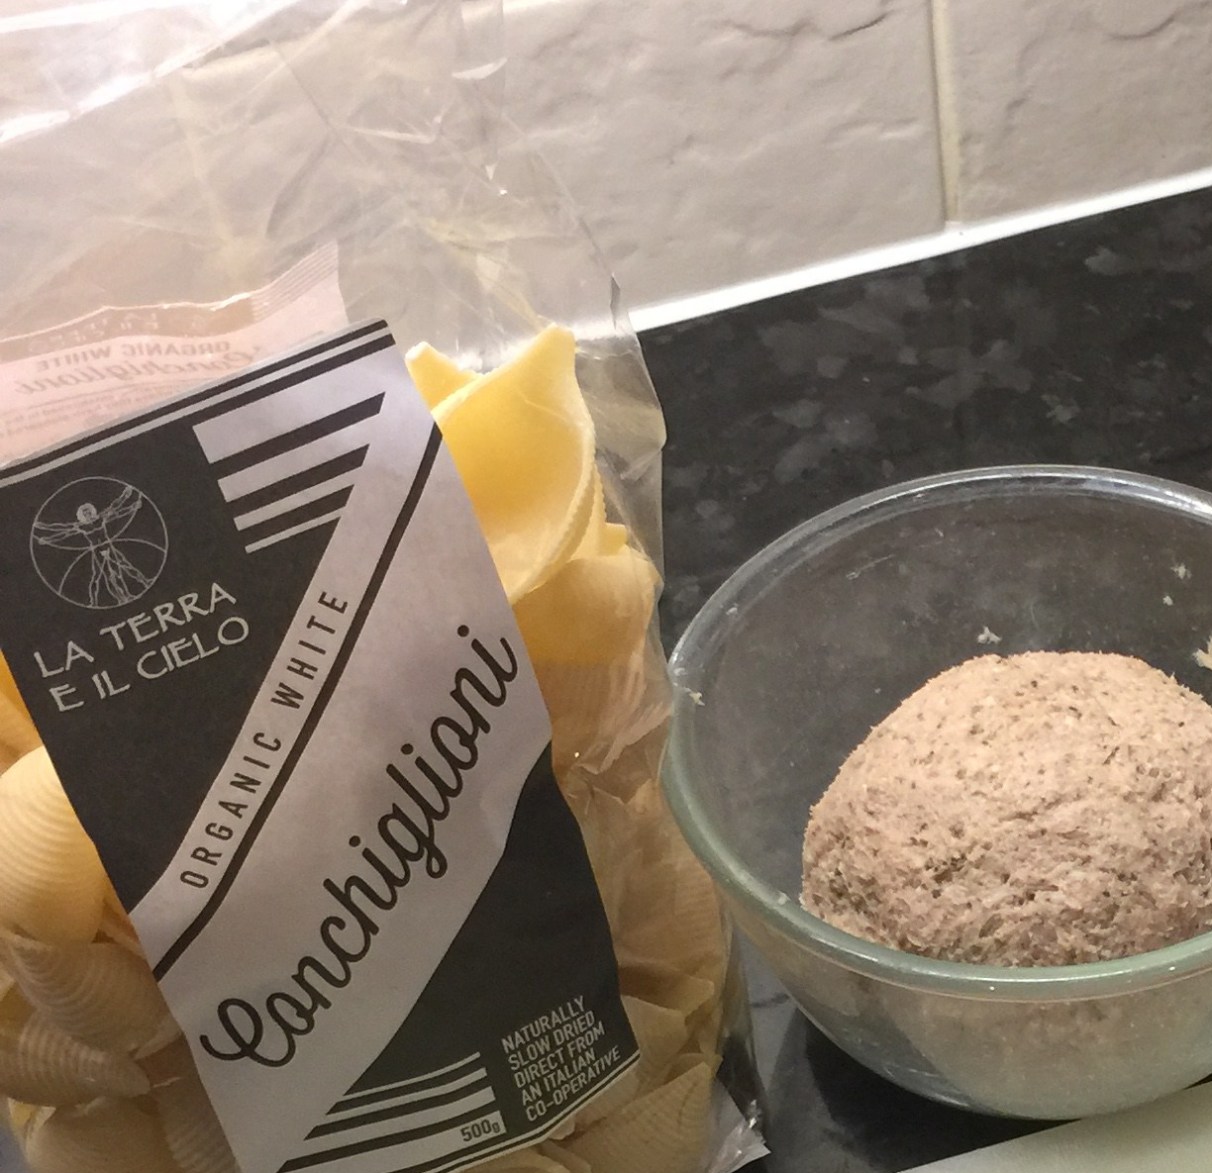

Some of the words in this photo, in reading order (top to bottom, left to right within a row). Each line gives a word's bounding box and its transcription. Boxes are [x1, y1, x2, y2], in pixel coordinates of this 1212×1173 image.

[34, 640, 94, 678] LA
[100, 582, 237, 651] TERRA
[49, 684, 84, 712] E
[92, 670, 131, 700] IL
[137, 616, 249, 679] CIELO
[180, 732, 281, 889] ORGANIC
[270, 591, 348, 709] WHITE
[200, 624, 518, 1067] Conchiglioni
[501, 995, 586, 1053] NATURALLY
[507, 1036, 551, 1071] SLOW
[553, 1010, 595, 1047] DRIED
[514, 1047, 565, 1089] DIRECT
[567, 1020, 605, 1058] FROM
[521, 1082, 543, 1106] AN
[543, 1047, 597, 1092] ITALIAN
[525, 1045, 622, 1122] CO-OPERATIVE
[460, 1118, 501, 1142] 500g
